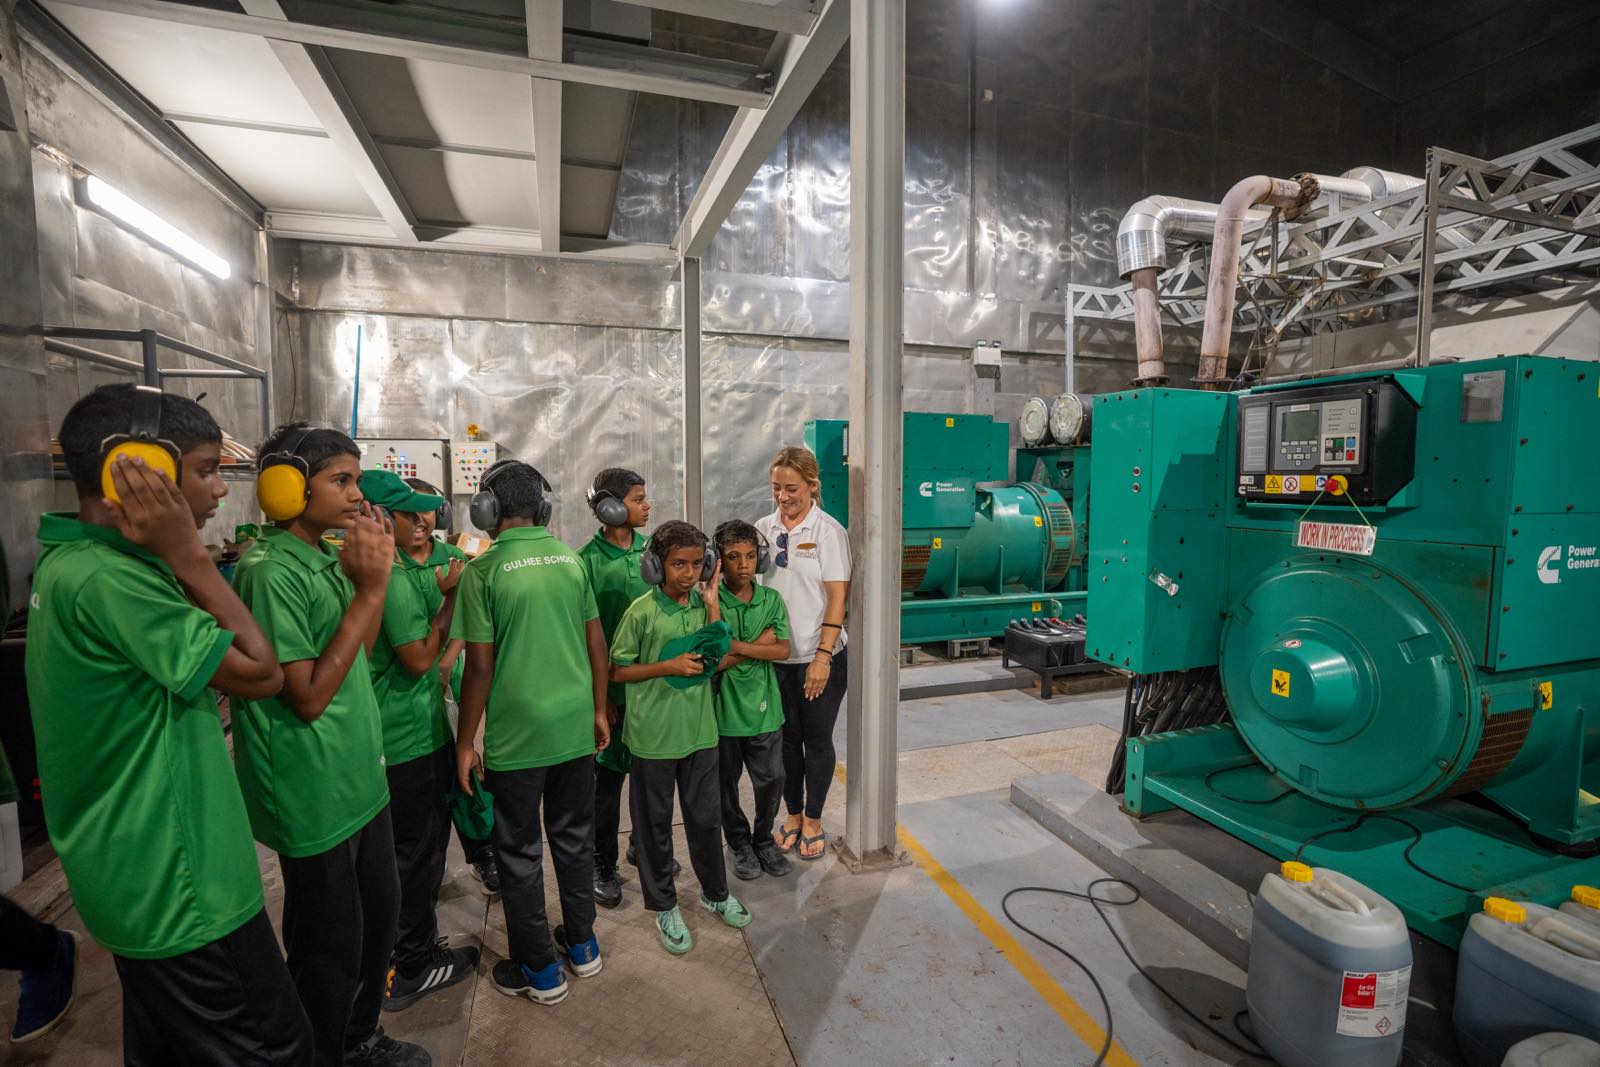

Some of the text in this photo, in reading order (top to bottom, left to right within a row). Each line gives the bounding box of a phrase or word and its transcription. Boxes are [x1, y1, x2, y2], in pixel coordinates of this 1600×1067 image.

[1300, 523, 1366, 552] WORK IN PROGRESS
[1568, 545, 1597, 557] Power
[503, 557, 542, 572] GULHEE
